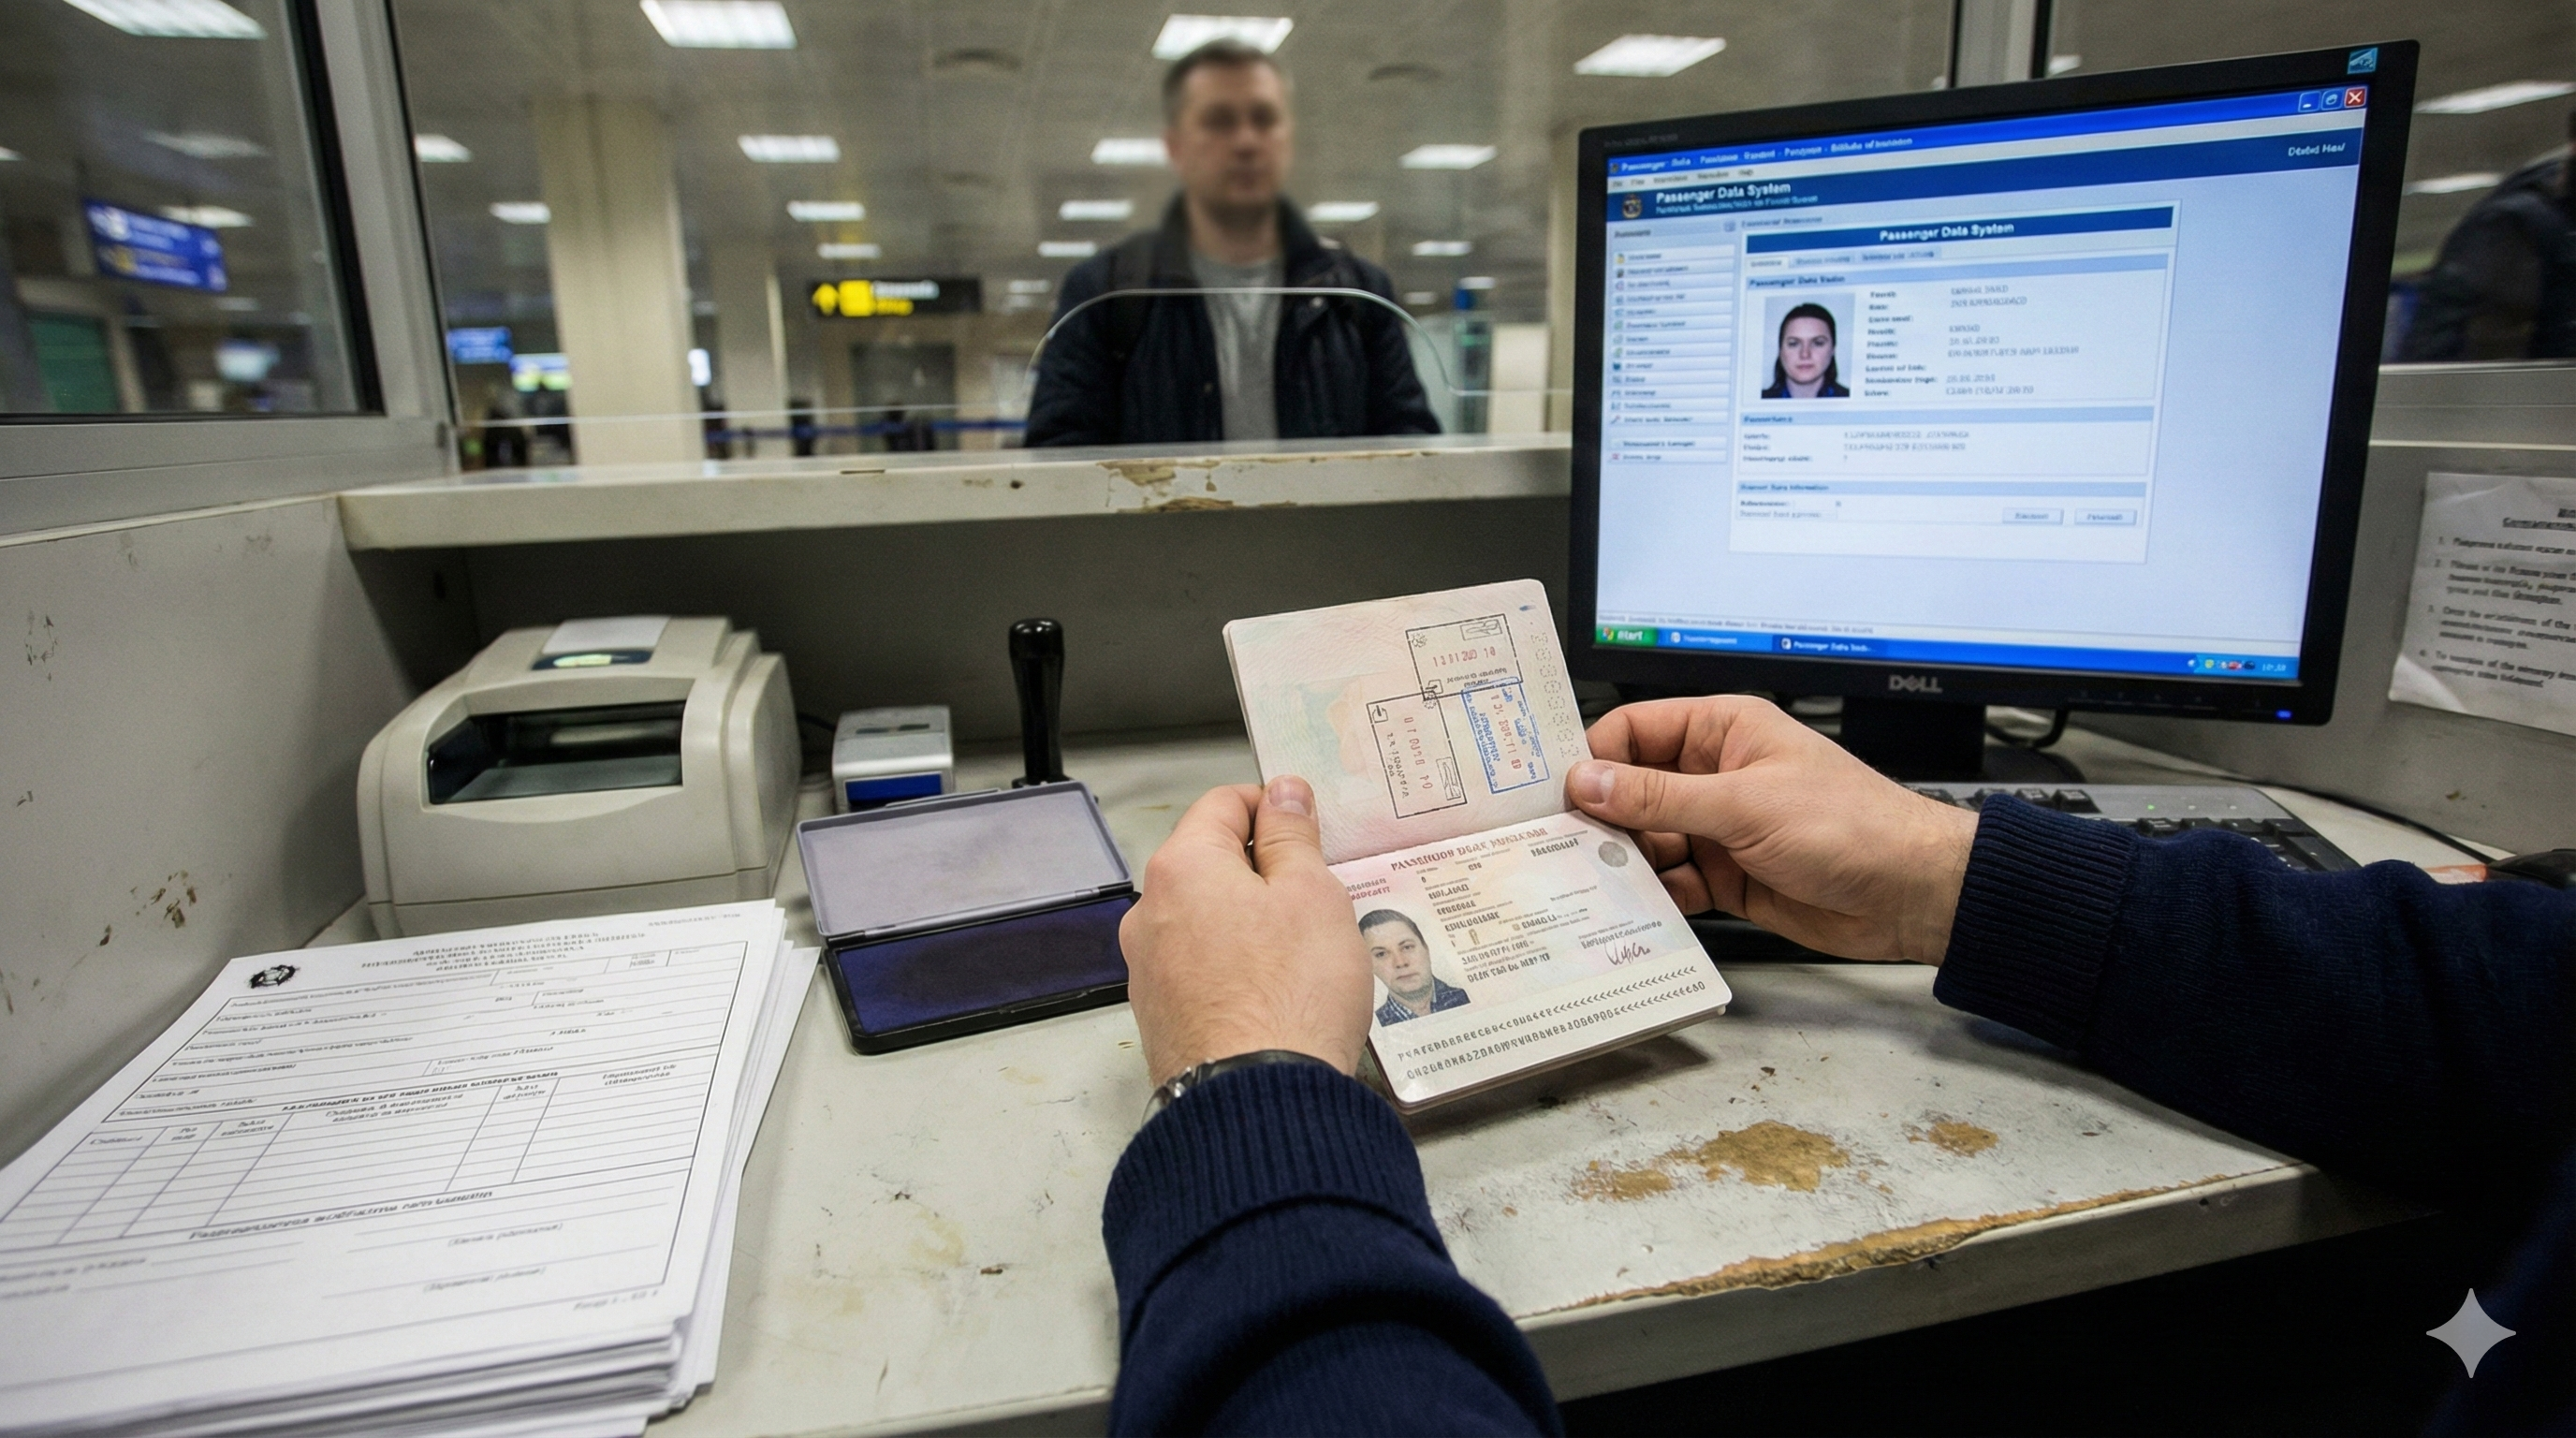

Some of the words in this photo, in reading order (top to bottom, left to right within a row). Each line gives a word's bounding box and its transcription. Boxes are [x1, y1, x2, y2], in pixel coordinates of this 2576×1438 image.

[1656, 188, 1716, 204] Passenger
[1718, 186, 1745, 199] Data
[1747, 183, 1792, 199] System
[1880, 226, 1939, 243] Passenger
[1940, 226, 1969, 239] Data
[1970, 222, 2014, 237] System
[1888, 674, 1942, 693] DELL
